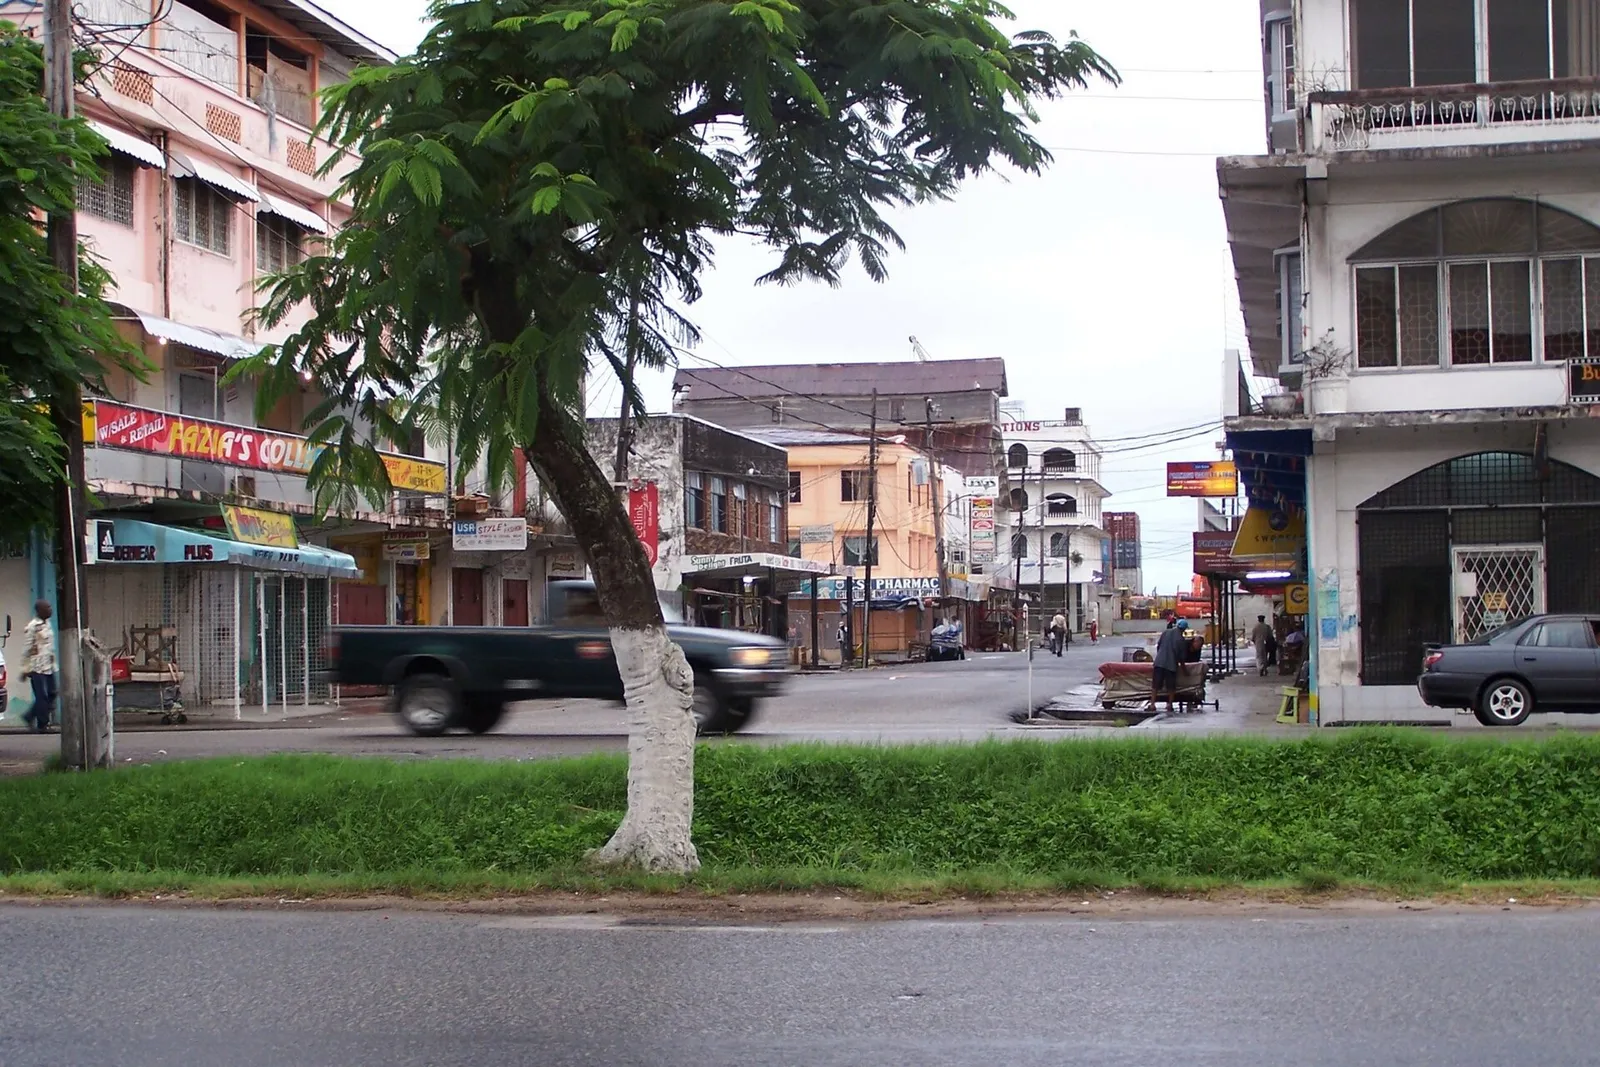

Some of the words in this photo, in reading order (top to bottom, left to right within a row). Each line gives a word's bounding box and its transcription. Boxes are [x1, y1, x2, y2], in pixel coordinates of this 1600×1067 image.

[99, 412, 137, 440] W/SALE
[120, 435, 127, 444] &
[130, 418, 165, 444] RETAIL
[1001, 422, 1040, 432] TIONS
[457, 523, 475, 532] USA
[478, 523, 503, 534] STYLE
[184, 544, 213, 560] PLUS
[730, 555, 752, 565] FRUTA
[875, 578, 939, 589] PHARMAC
